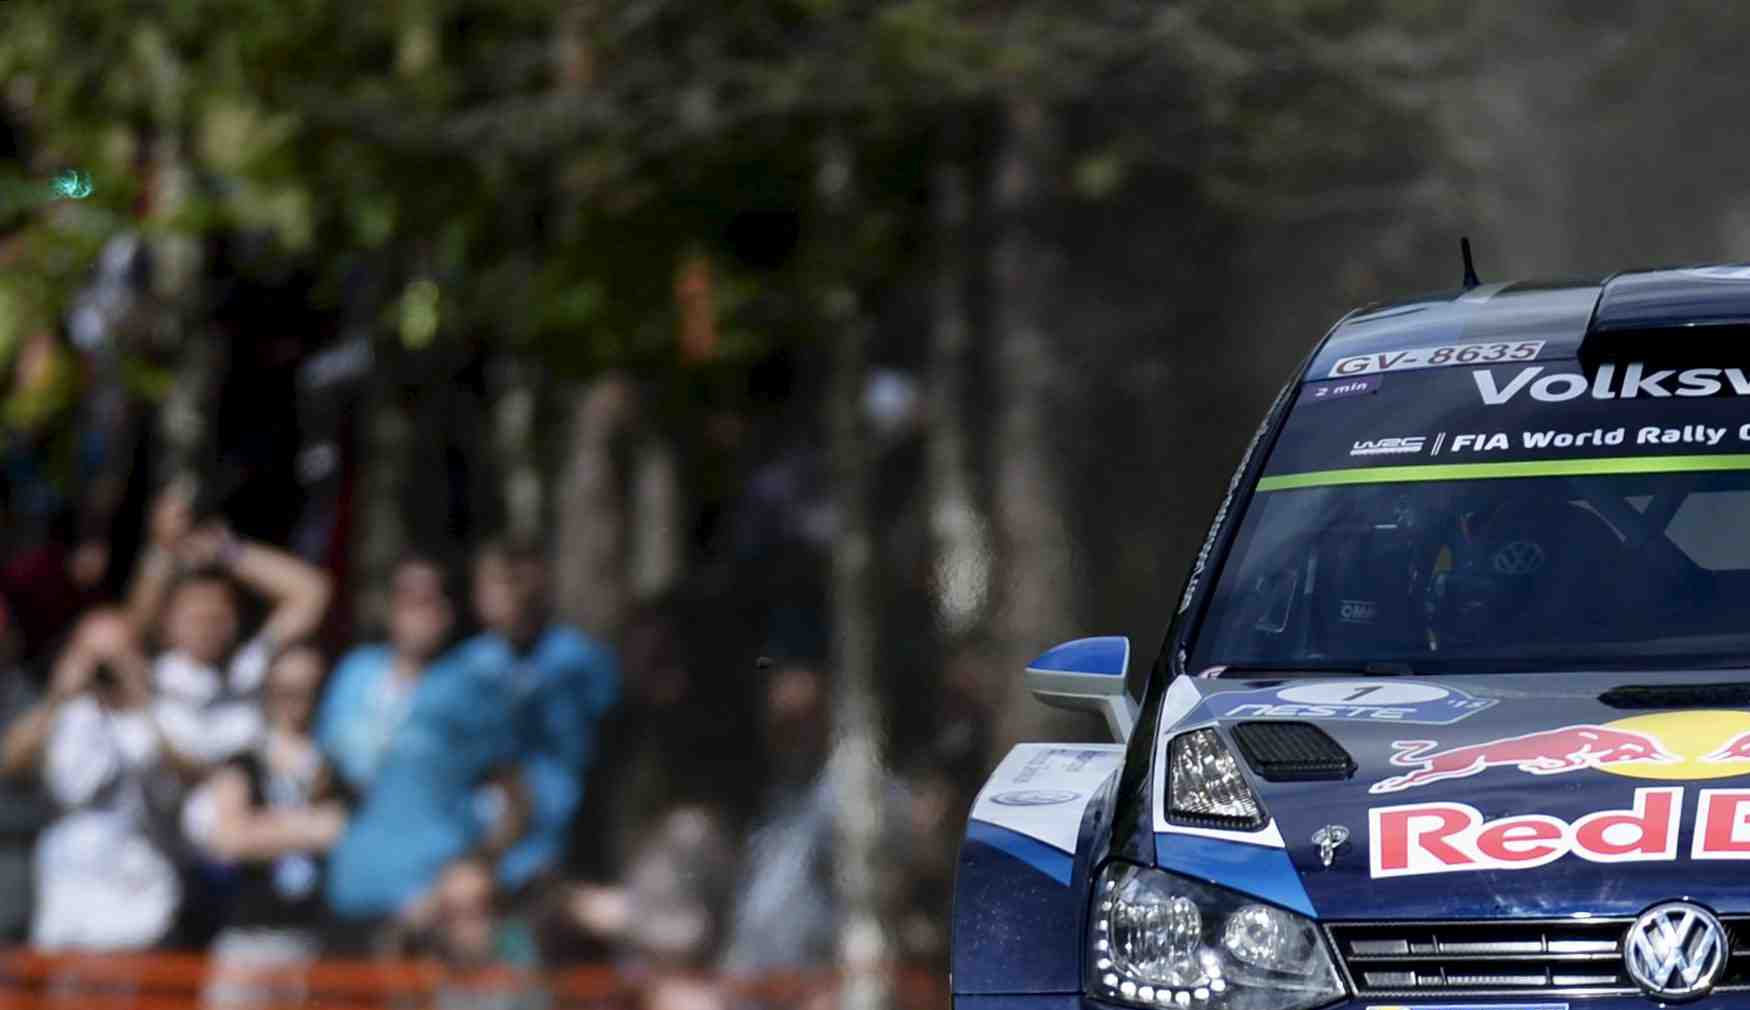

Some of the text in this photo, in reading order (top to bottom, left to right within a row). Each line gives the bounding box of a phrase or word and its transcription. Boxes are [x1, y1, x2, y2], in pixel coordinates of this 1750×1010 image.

[1315, 382, 1368, 397] 2 min
[1450, 432, 1509, 452] FIA
[1522, 426, 1625, 449] World
[1636, 424, 1727, 446] Rally
[1342, 685, 1384, 702] 1
[1380, 791, 1673, 872] Red
